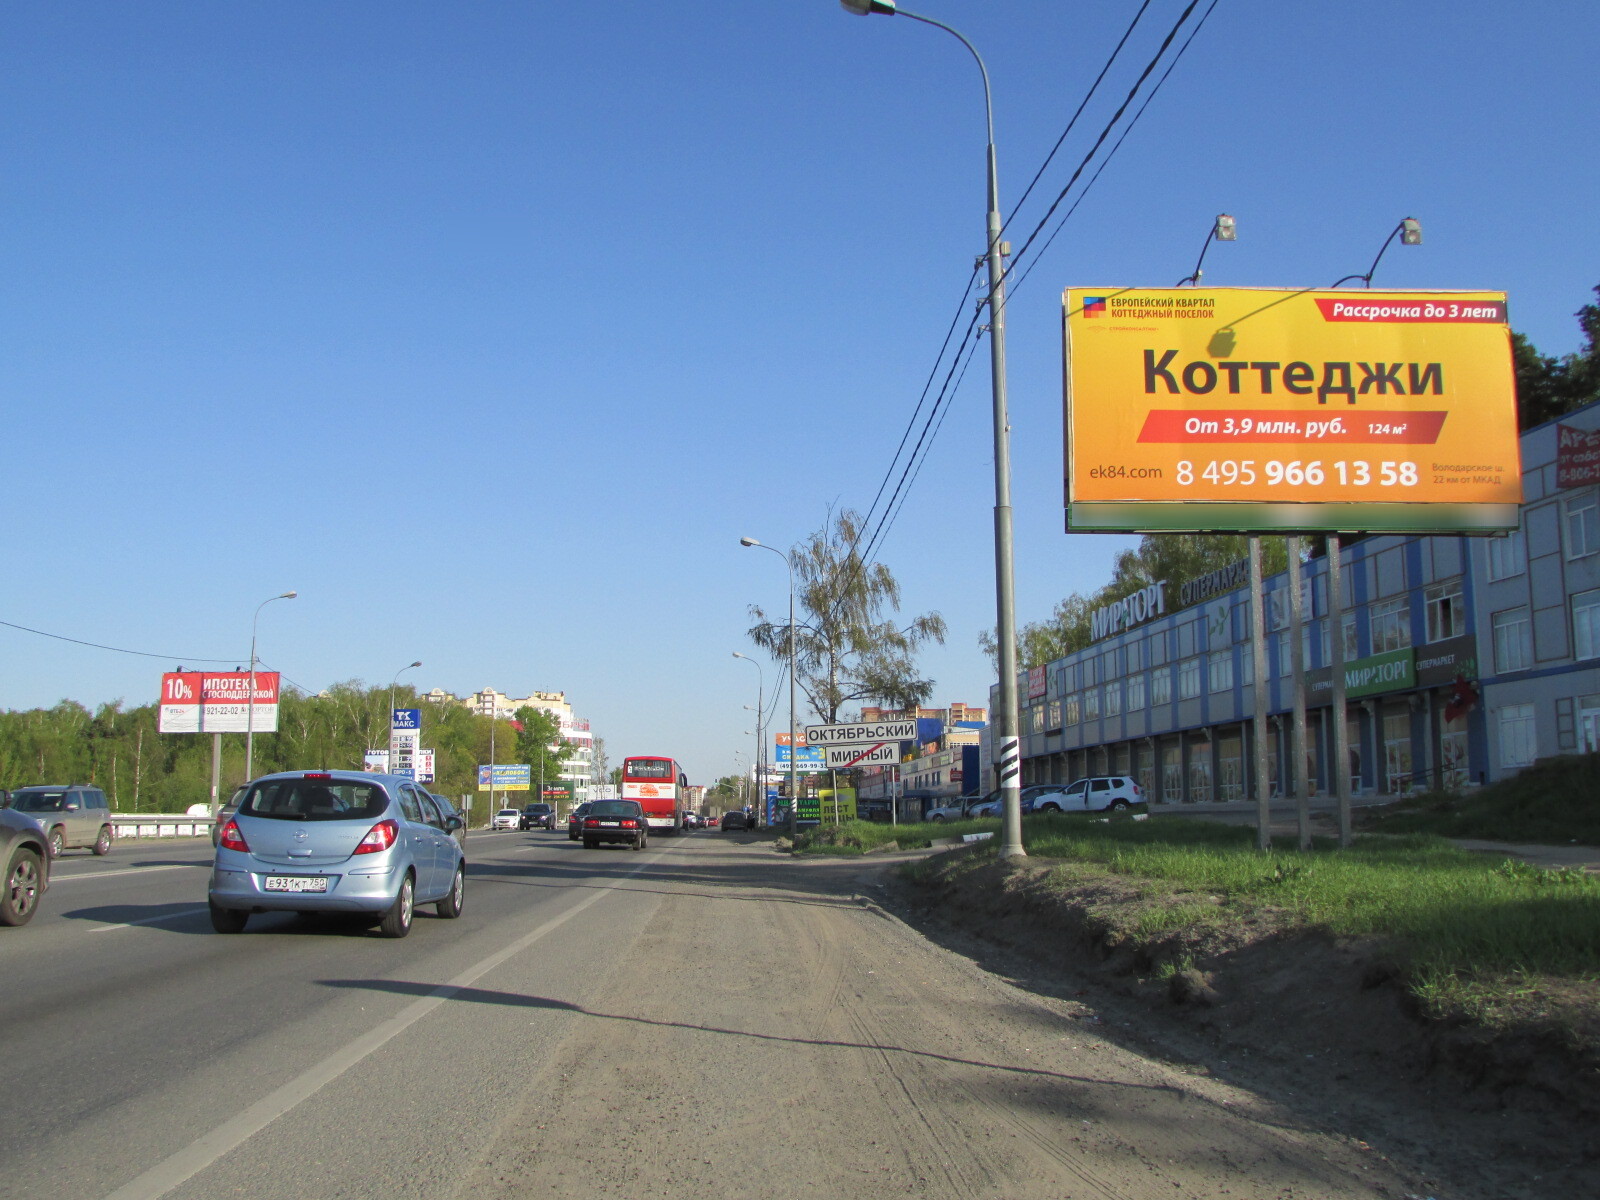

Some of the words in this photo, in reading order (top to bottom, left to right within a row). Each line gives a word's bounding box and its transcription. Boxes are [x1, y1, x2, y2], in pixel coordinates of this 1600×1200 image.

[1111, 297, 1174, 308] ЕВРОПЕЙСКИЙ
[1176, 299, 1215, 308] КВАРТАЛ
[1111, 308, 1173, 319] КОТТЕДЖНЫЙ
[1175, 309, 1214, 319] ПОСЕЛОК
[1333, 302, 1421, 320] Рассрочка
[1424, 303, 1446, 318] до
[1448, 304, 1459, 318] 3
[1462, 306, 1497, 318] лет
[1143, 349, 1444, 405] Коттеджи
[1185, 418, 1219, 434] От
[1222, 418, 1253, 436] 3,9
[1256, 421, 1301, 434] млн.
[1305, 418, 1347, 438] руб.
[1368, 424, 1390, 434] 124
[1089, 465, 1162, 479] ek84.com
[1176, 460, 1194, 486] 8
[1201, 460, 1256, 486] 495
[1264, 461, 1325, 486] 966
[1333, 461, 1371, 486] 13
[1380, 461, 1418, 487] 58
[1432, 462, 1493, 474] Володарское
[1495, 464, 1505, 473] ш.
[1433, 475, 1444, 484] 22
[1446, 477, 1459, 485] км
[1460, 477, 1471, 485] от
[1472, 475, 1502, 485] МКАД
[1090, 579, 1167, 642] МИРАТОРГ
[167, 678, 193, 699] 10%
[203, 678, 258, 690] ИПОТЕКА
[206, 706, 239, 715] 921-22-02
[393, 720, 415, 728] МАКС
[808, 722, 915, 741] ОКТЯБРЬСКИЙ
[831, 746, 894, 763] МИРНЫЙ
